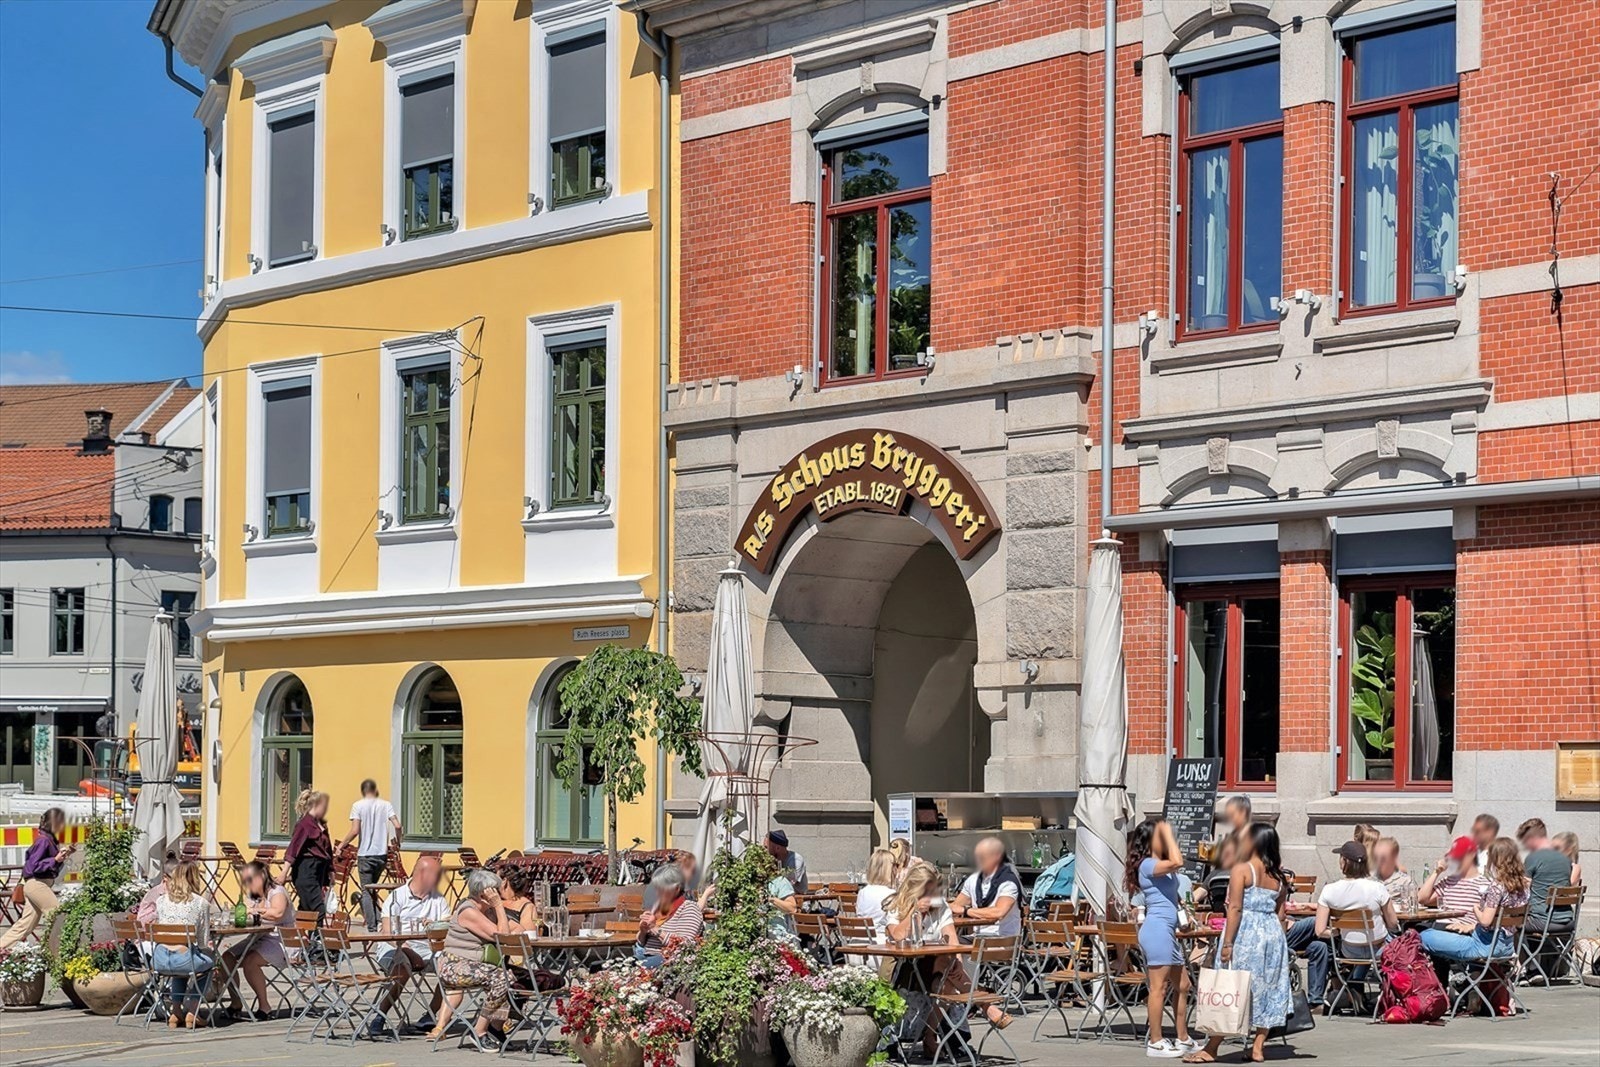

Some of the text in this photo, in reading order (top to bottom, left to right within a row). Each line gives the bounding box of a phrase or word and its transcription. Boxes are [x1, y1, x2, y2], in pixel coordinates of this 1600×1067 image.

[771, 442, 866, 512] Schous
[870, 432, 986, 542] Bryggeri
[611, 629, 625, 637] plass
[1176, 763, 1211, 781] LUNSJ
[1197, 988, 1240, 1007] tricot
